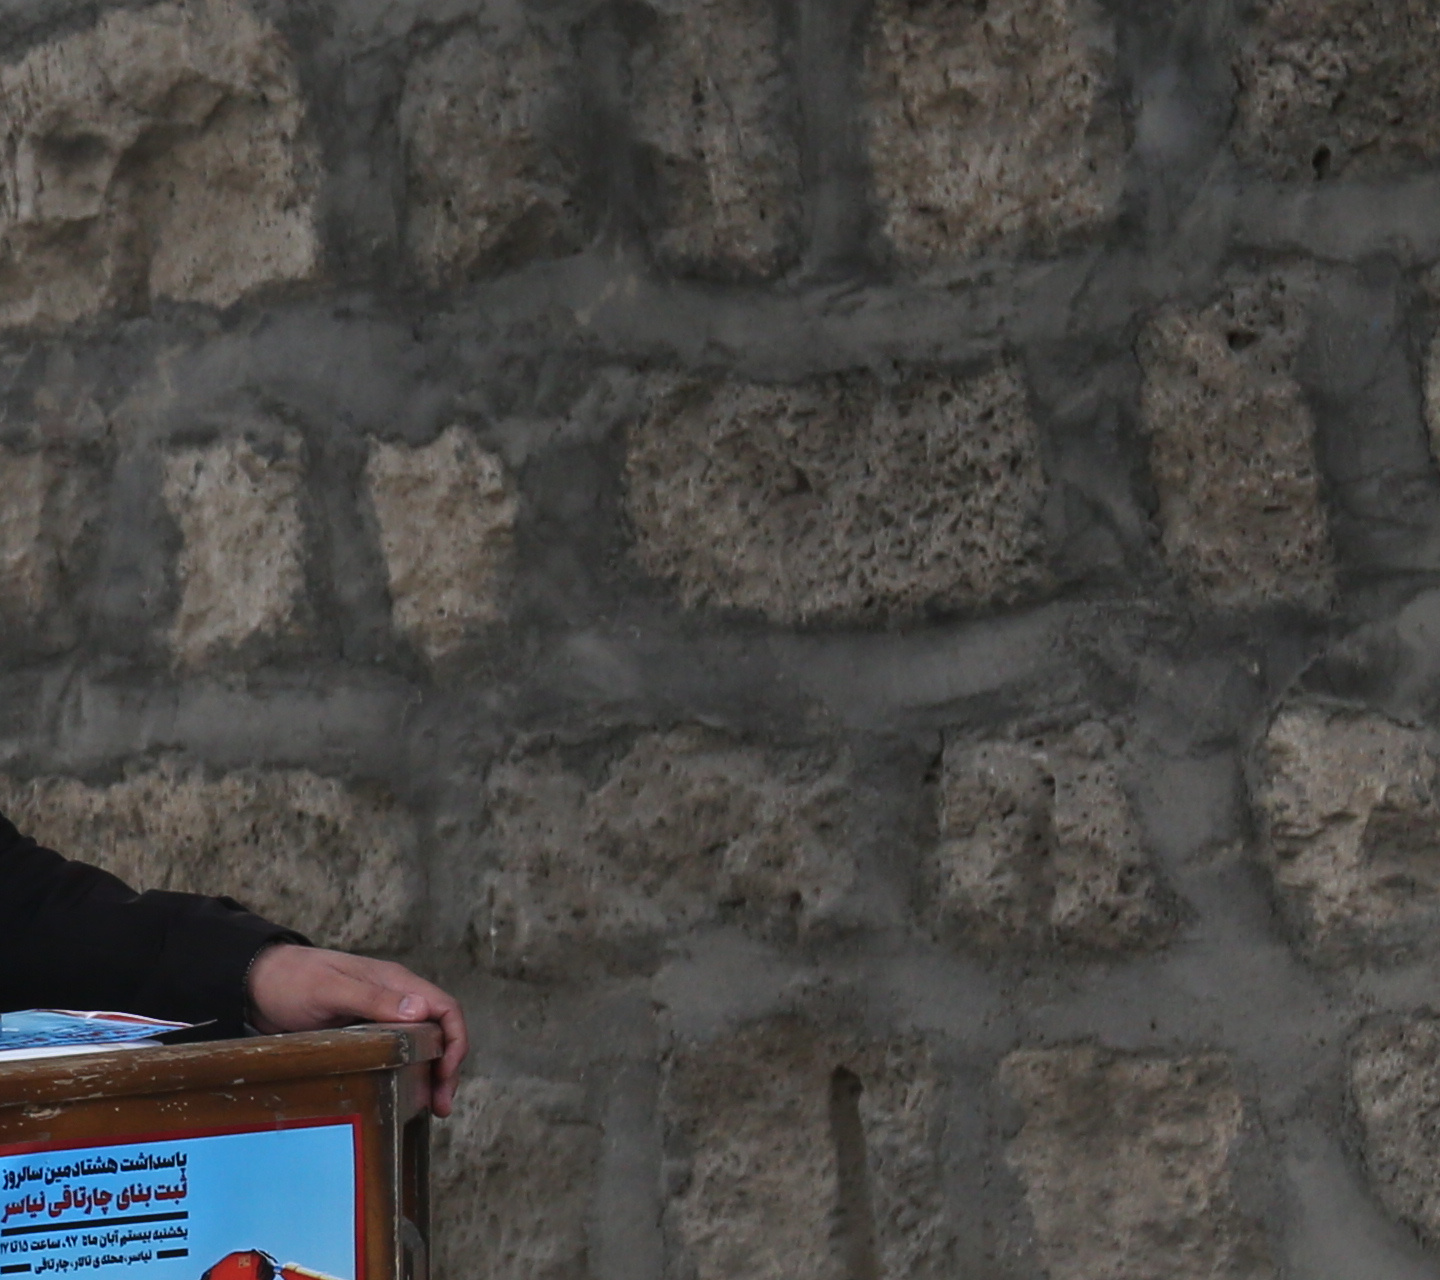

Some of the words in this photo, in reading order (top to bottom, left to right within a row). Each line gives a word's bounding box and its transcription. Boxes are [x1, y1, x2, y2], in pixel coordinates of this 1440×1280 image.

[45, 1156, 117, 1185] هشتادمین
[120, 1152, 187, 1174] پاسداشت
[2, 1165, 43, 1190] سالروز
[117, 1183, 152, 1210] بنای
[154, 1174, 187, 1204] ثبت
[1, 1191, 45, 1223] نیاسر
[48, 1185, 113, 1217] چارتاقی
[30, 1237, 60, 1251] ساعت
[82, 1234, 98, 1246] ماه
[99, 1229, 118, 1248] آبان
[120, 1229, 151, 1246] بیستم
[153, 1226, 188, 1240] یکشنبه
[10, 1240, 19, 1253] تا
